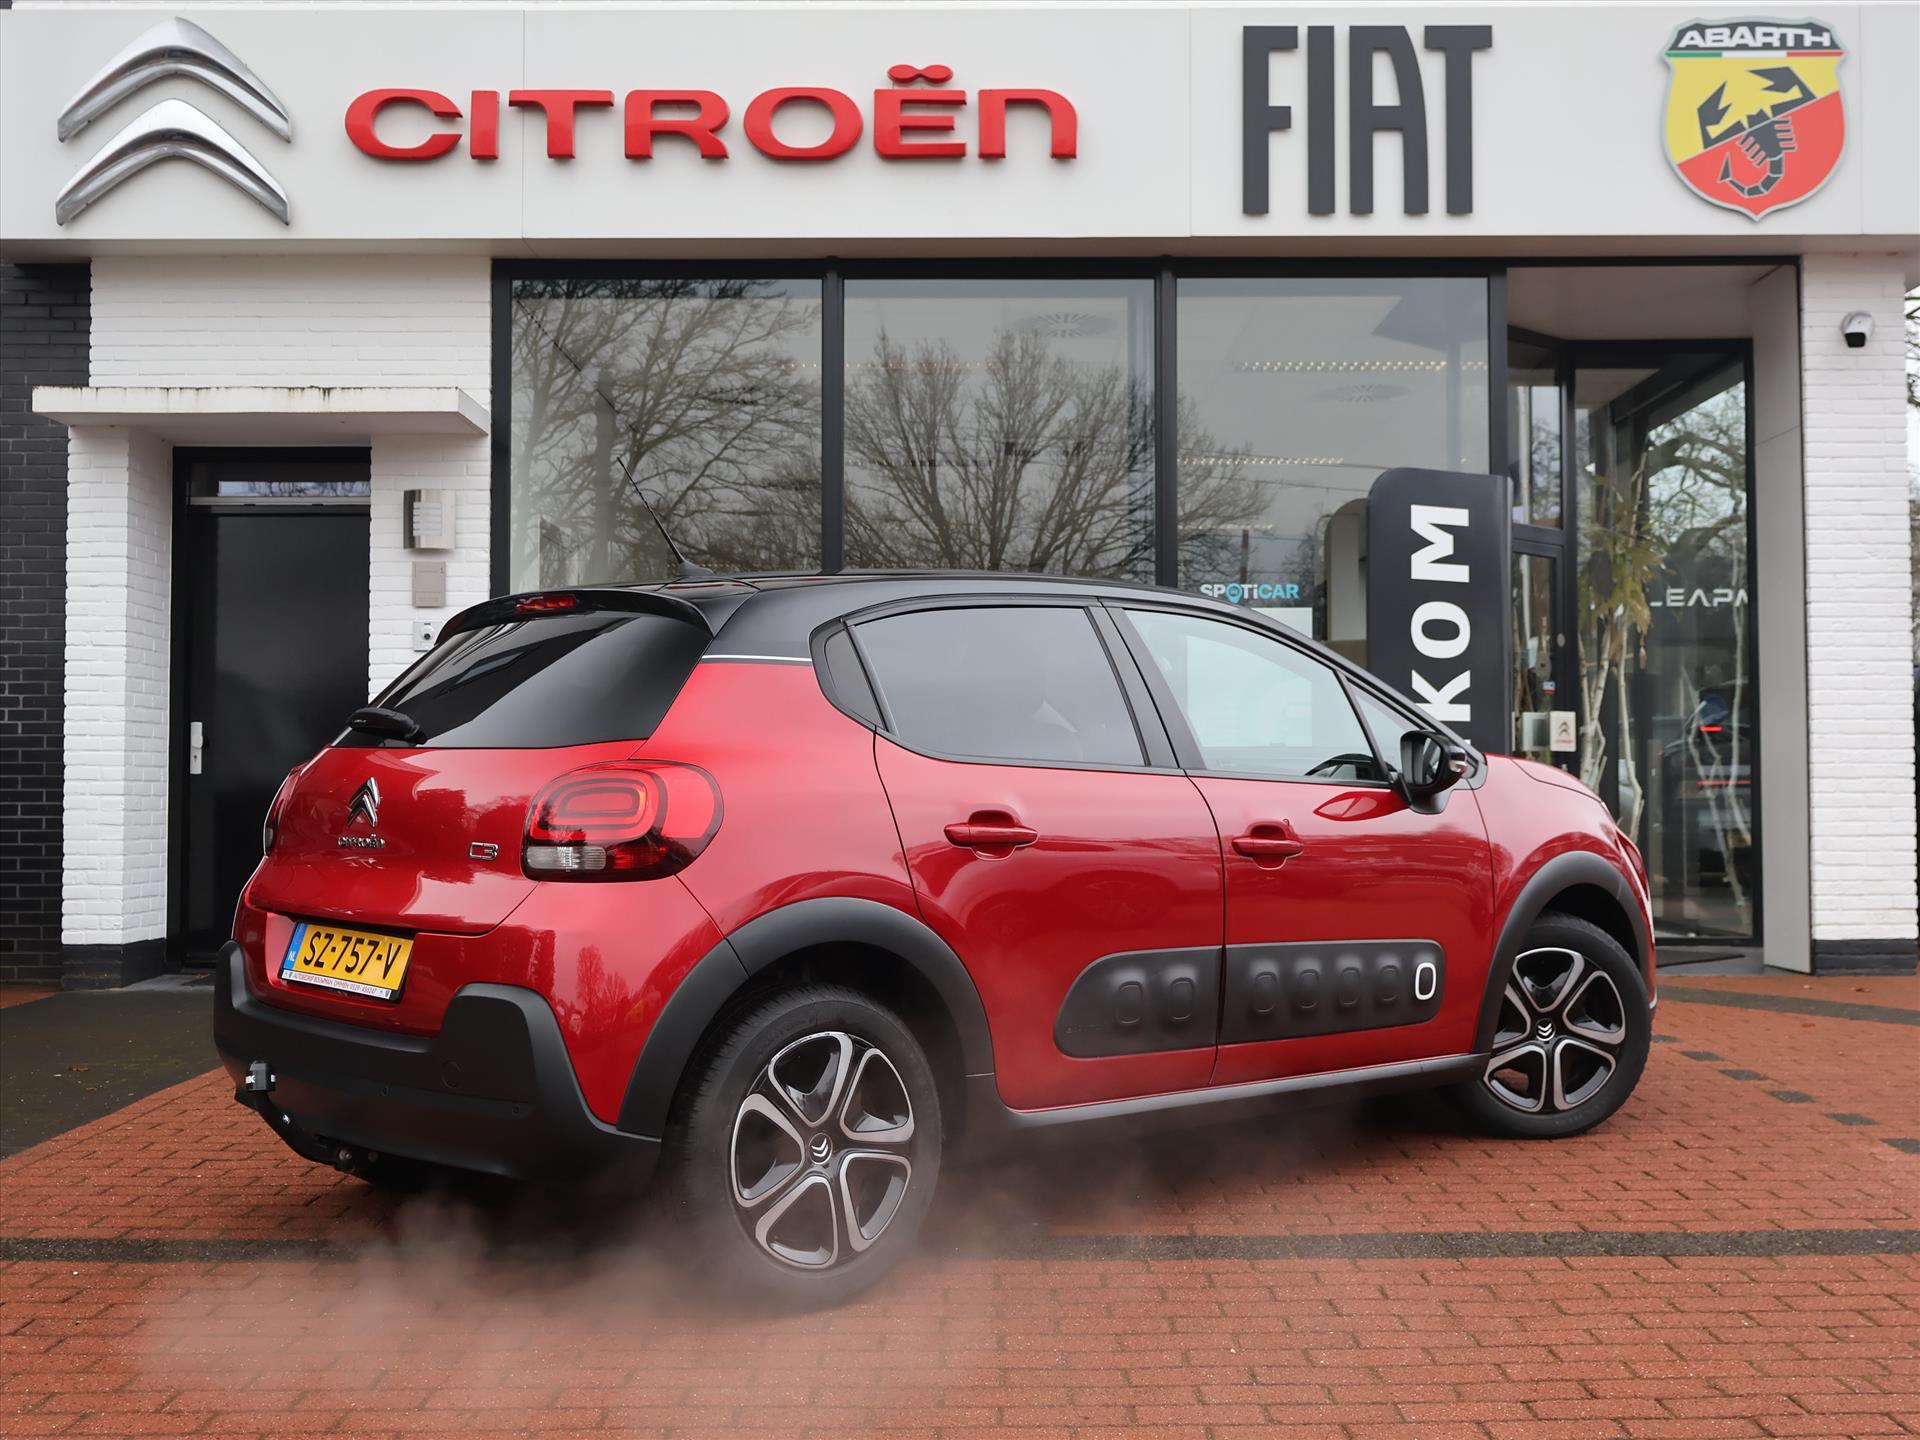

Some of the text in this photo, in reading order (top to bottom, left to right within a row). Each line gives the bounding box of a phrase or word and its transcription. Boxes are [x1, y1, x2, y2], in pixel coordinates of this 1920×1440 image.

[1678, 26, 1831, 48] ABARTH
[345, 64, 1078, 162] CITROËN
[1243, 26, 1493, 217] FIAT
[1411, 504, 1471, 745] KOM
[469, 842, 499, 860] C3
[287, 951, 297, 962] NL
[303, 931, 402, 980] SZ-757-V
